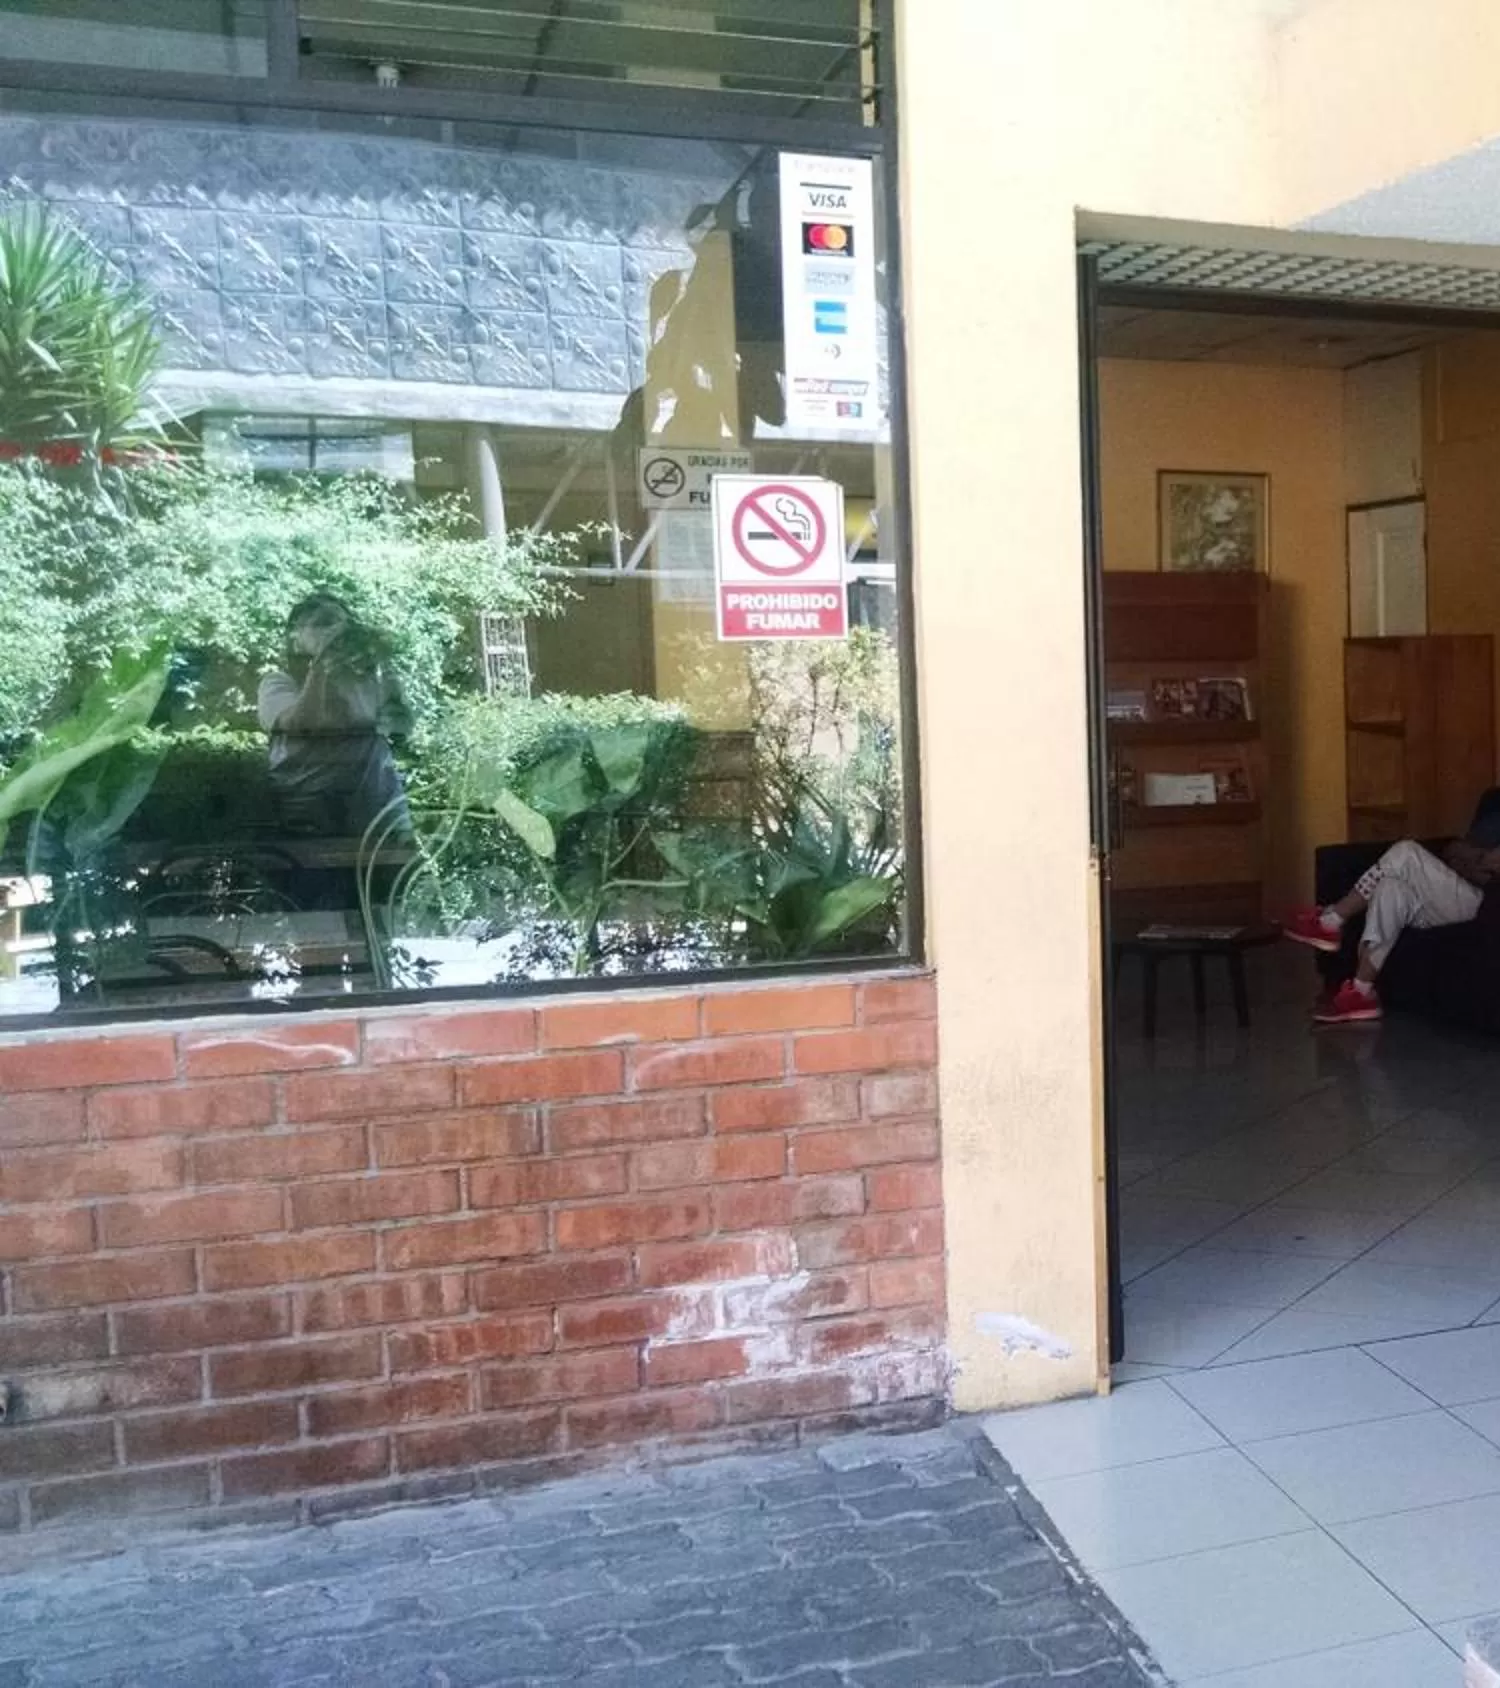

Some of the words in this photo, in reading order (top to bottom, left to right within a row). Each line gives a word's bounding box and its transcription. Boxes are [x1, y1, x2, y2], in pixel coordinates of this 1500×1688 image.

[808, 192, 847, 208] VISA
[726, 593, 838, 610] PROHIBIDO
[746, 613, 821, 630] FUMAR
